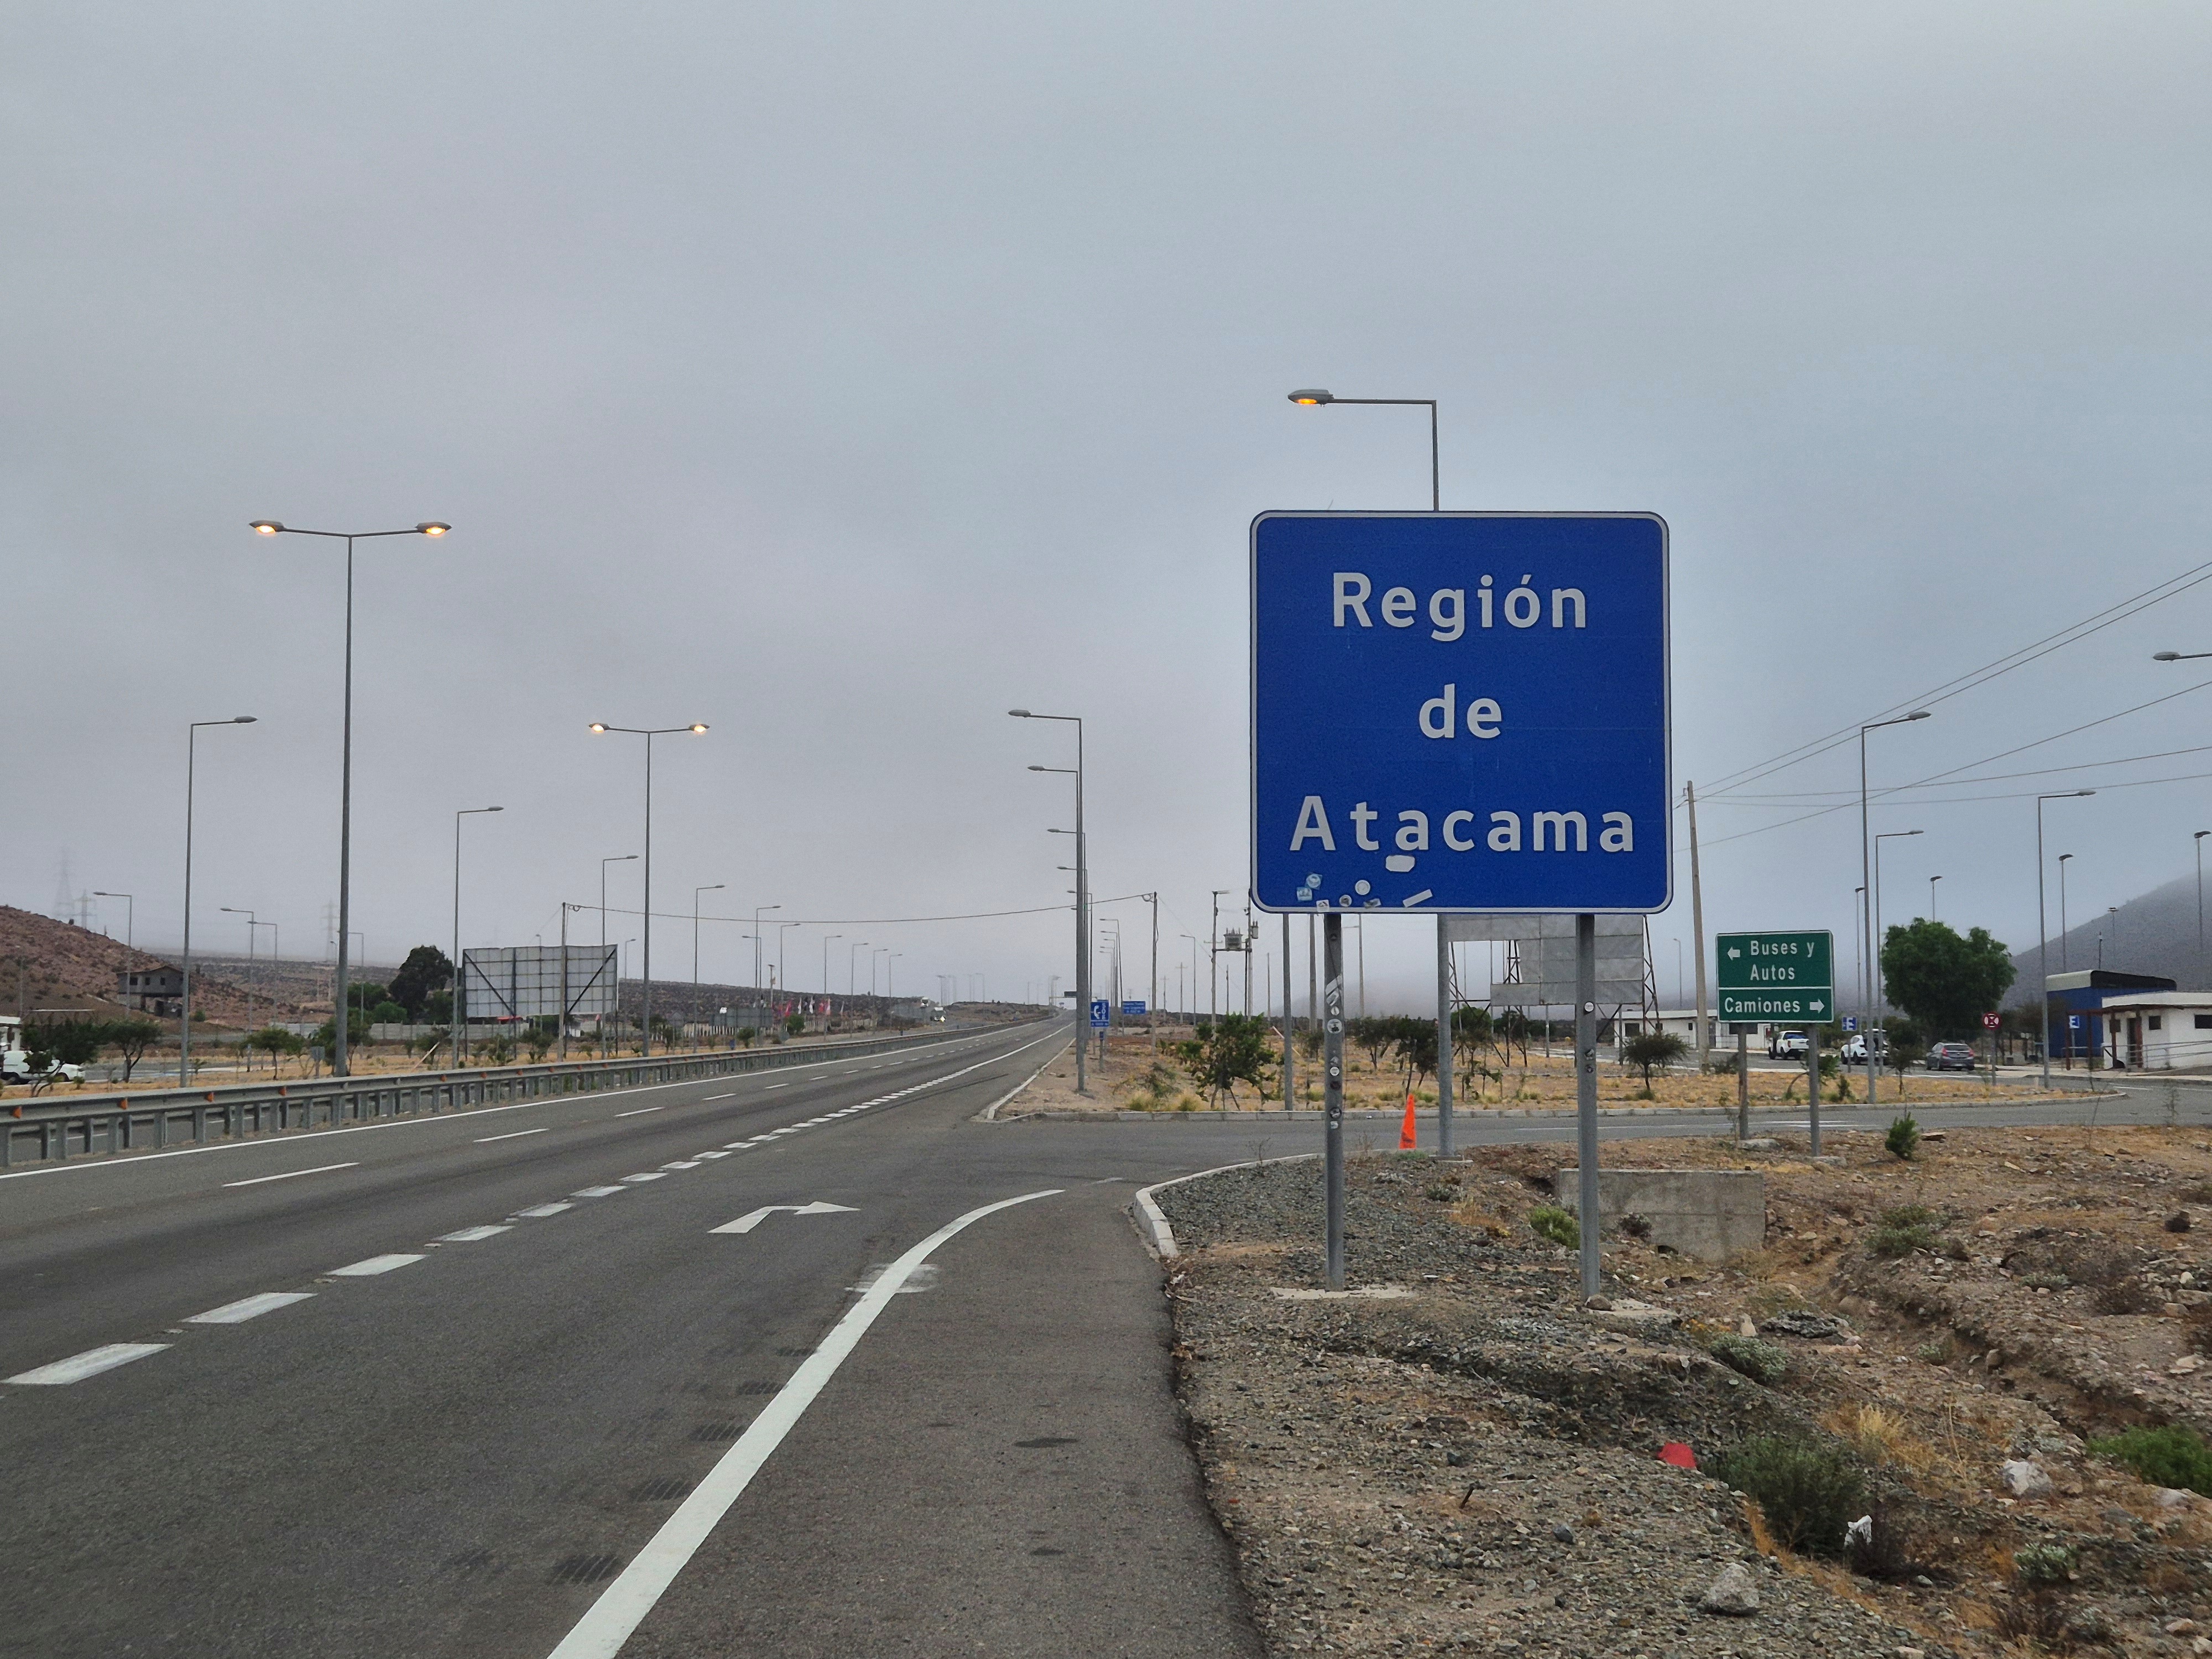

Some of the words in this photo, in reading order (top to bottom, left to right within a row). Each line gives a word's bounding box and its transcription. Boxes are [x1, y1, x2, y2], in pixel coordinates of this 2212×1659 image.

[1333, 572, 1587, 641] Región
[1419, 683, 1502, 738] de
[1290, 796, 1633, 852] Atacama
[1750, 941, 1797, 956] Buses
[1807, 942, 1814, 958] y
[1750, 964, 1795, 980] Autos
[1724, 997, 1801, 1013] Camiones
